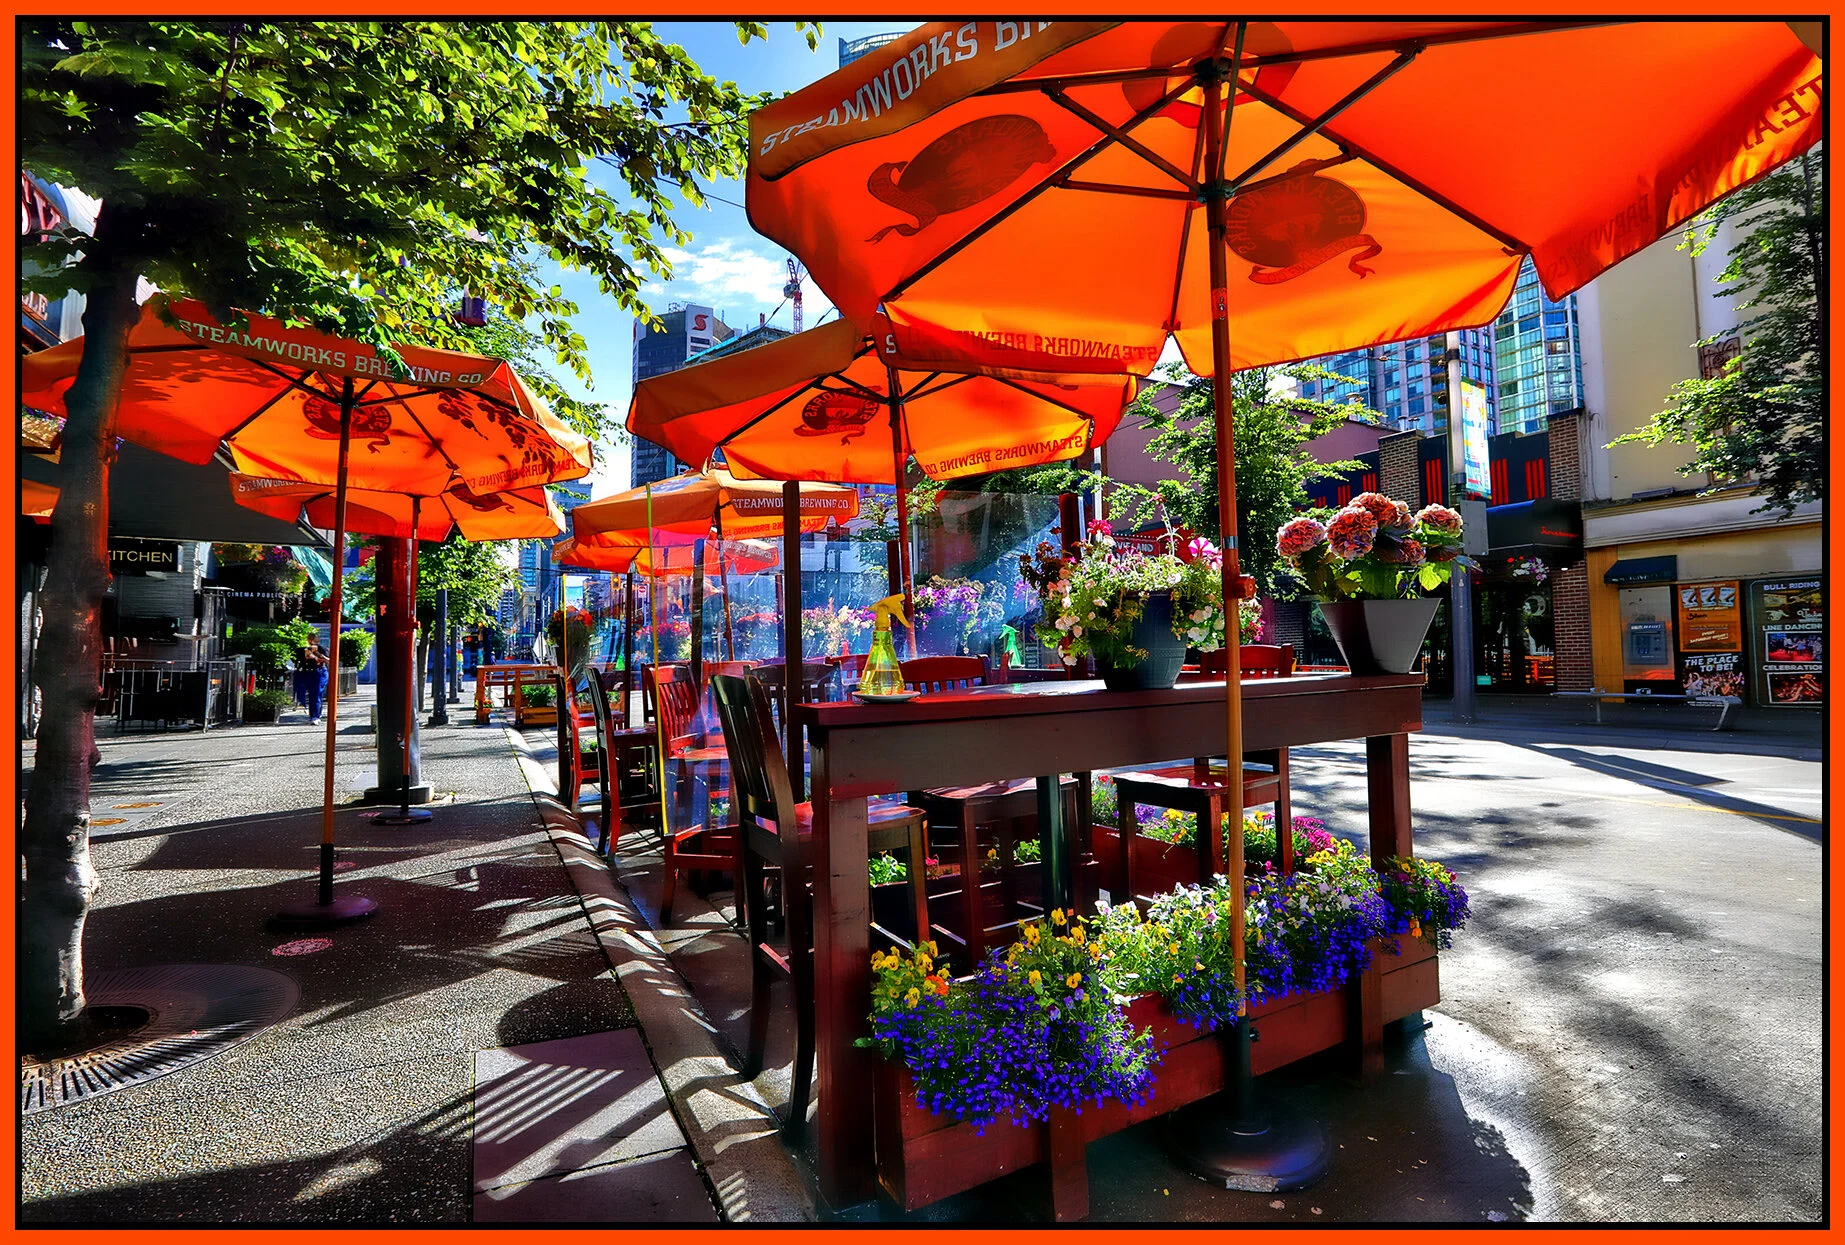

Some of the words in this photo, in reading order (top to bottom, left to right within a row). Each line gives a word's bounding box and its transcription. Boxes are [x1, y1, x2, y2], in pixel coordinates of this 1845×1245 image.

[760, 22, 978, 156] STEAMWORKS
[179, 319, 346, 368] STEAMWORKS
[732, 497, 784, 509] STEAMWO
[1788, 581, 1821, 589] RIDING
[1784, 623, 1822, 631] DANCIN
[1684, 658, 1705, 666] THE
[1706, 655, 1739, 665] PLACE
[1716, 663, 1734, 671] BE!
